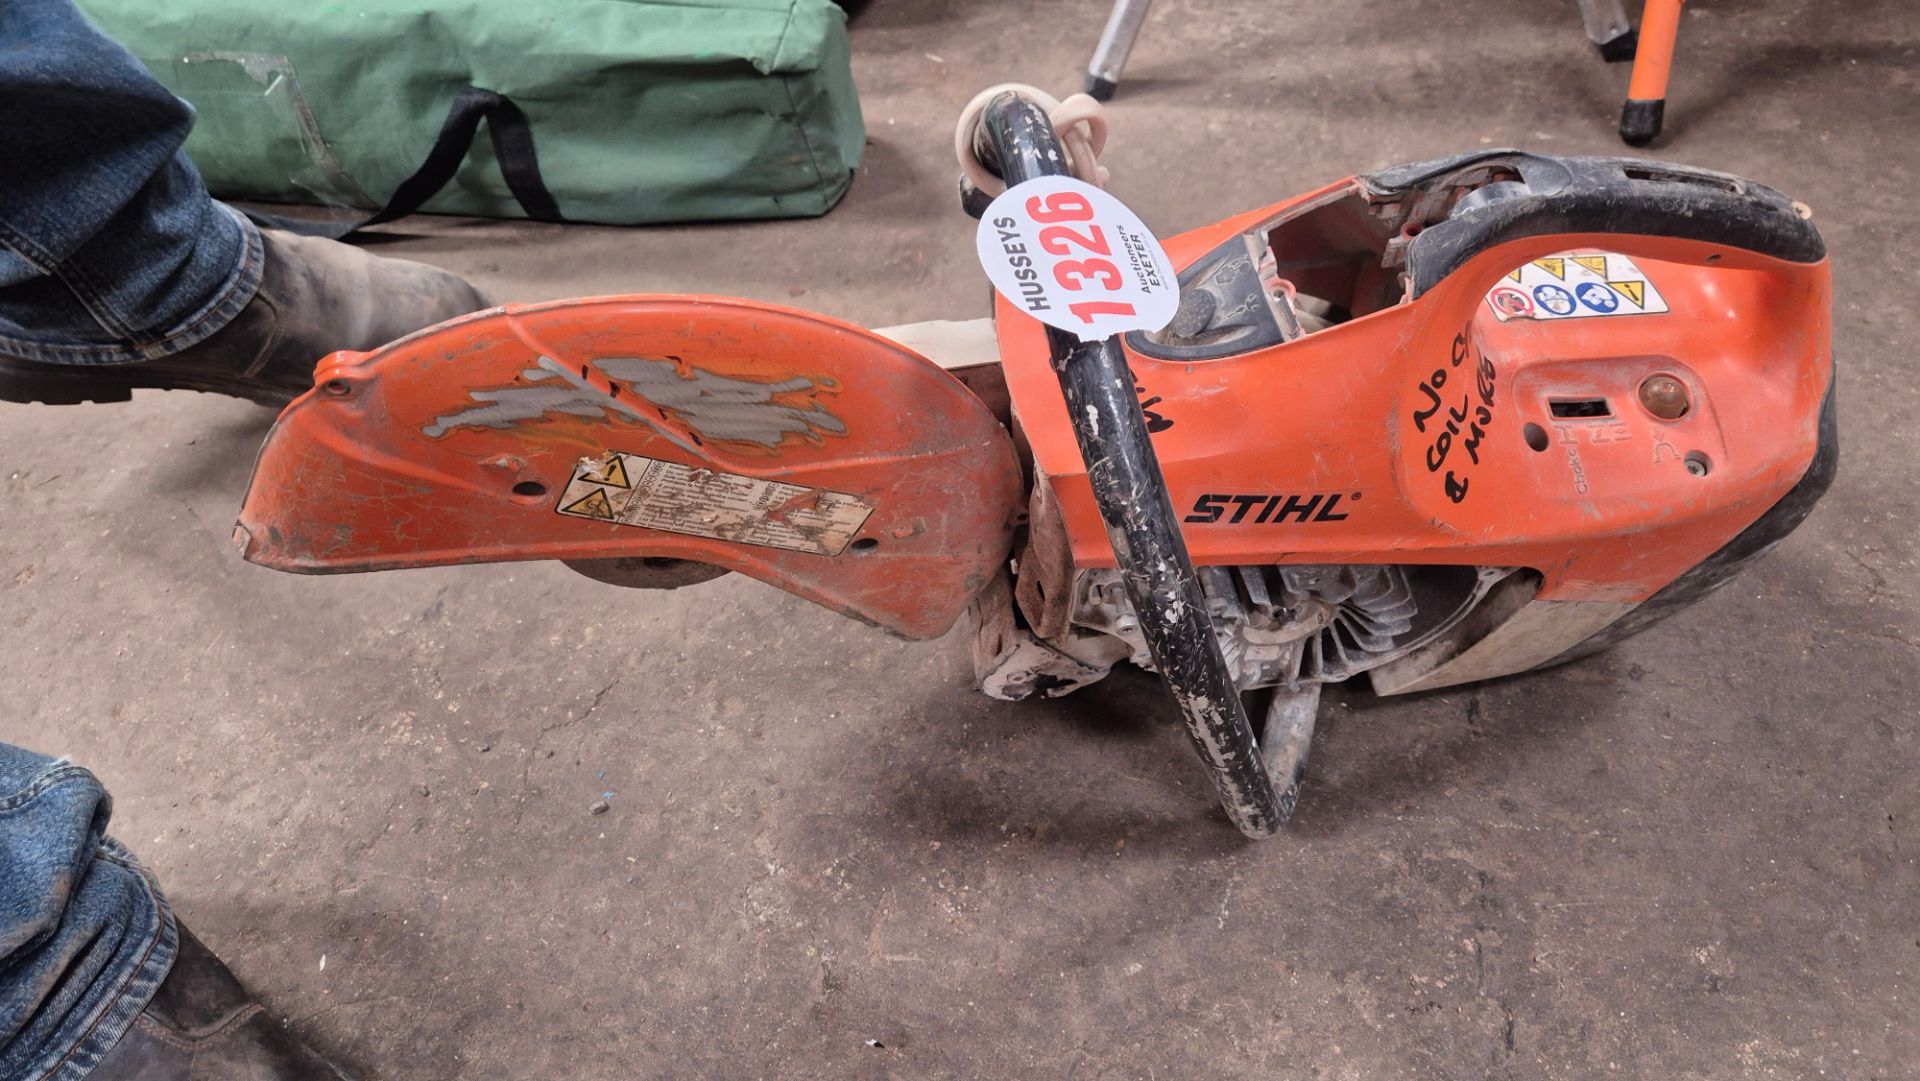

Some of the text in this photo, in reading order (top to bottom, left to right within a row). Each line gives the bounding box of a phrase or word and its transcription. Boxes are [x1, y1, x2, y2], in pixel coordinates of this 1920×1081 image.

[993, 216, 1051, 311] HUSSEYS
[1025, 191, 1137, 324] 1326
[1117, 224, 1152, 294] Auctioneers
[1130, 233, 1161, 287] EXETER
[1426, 394, 1468, 472] COIL
